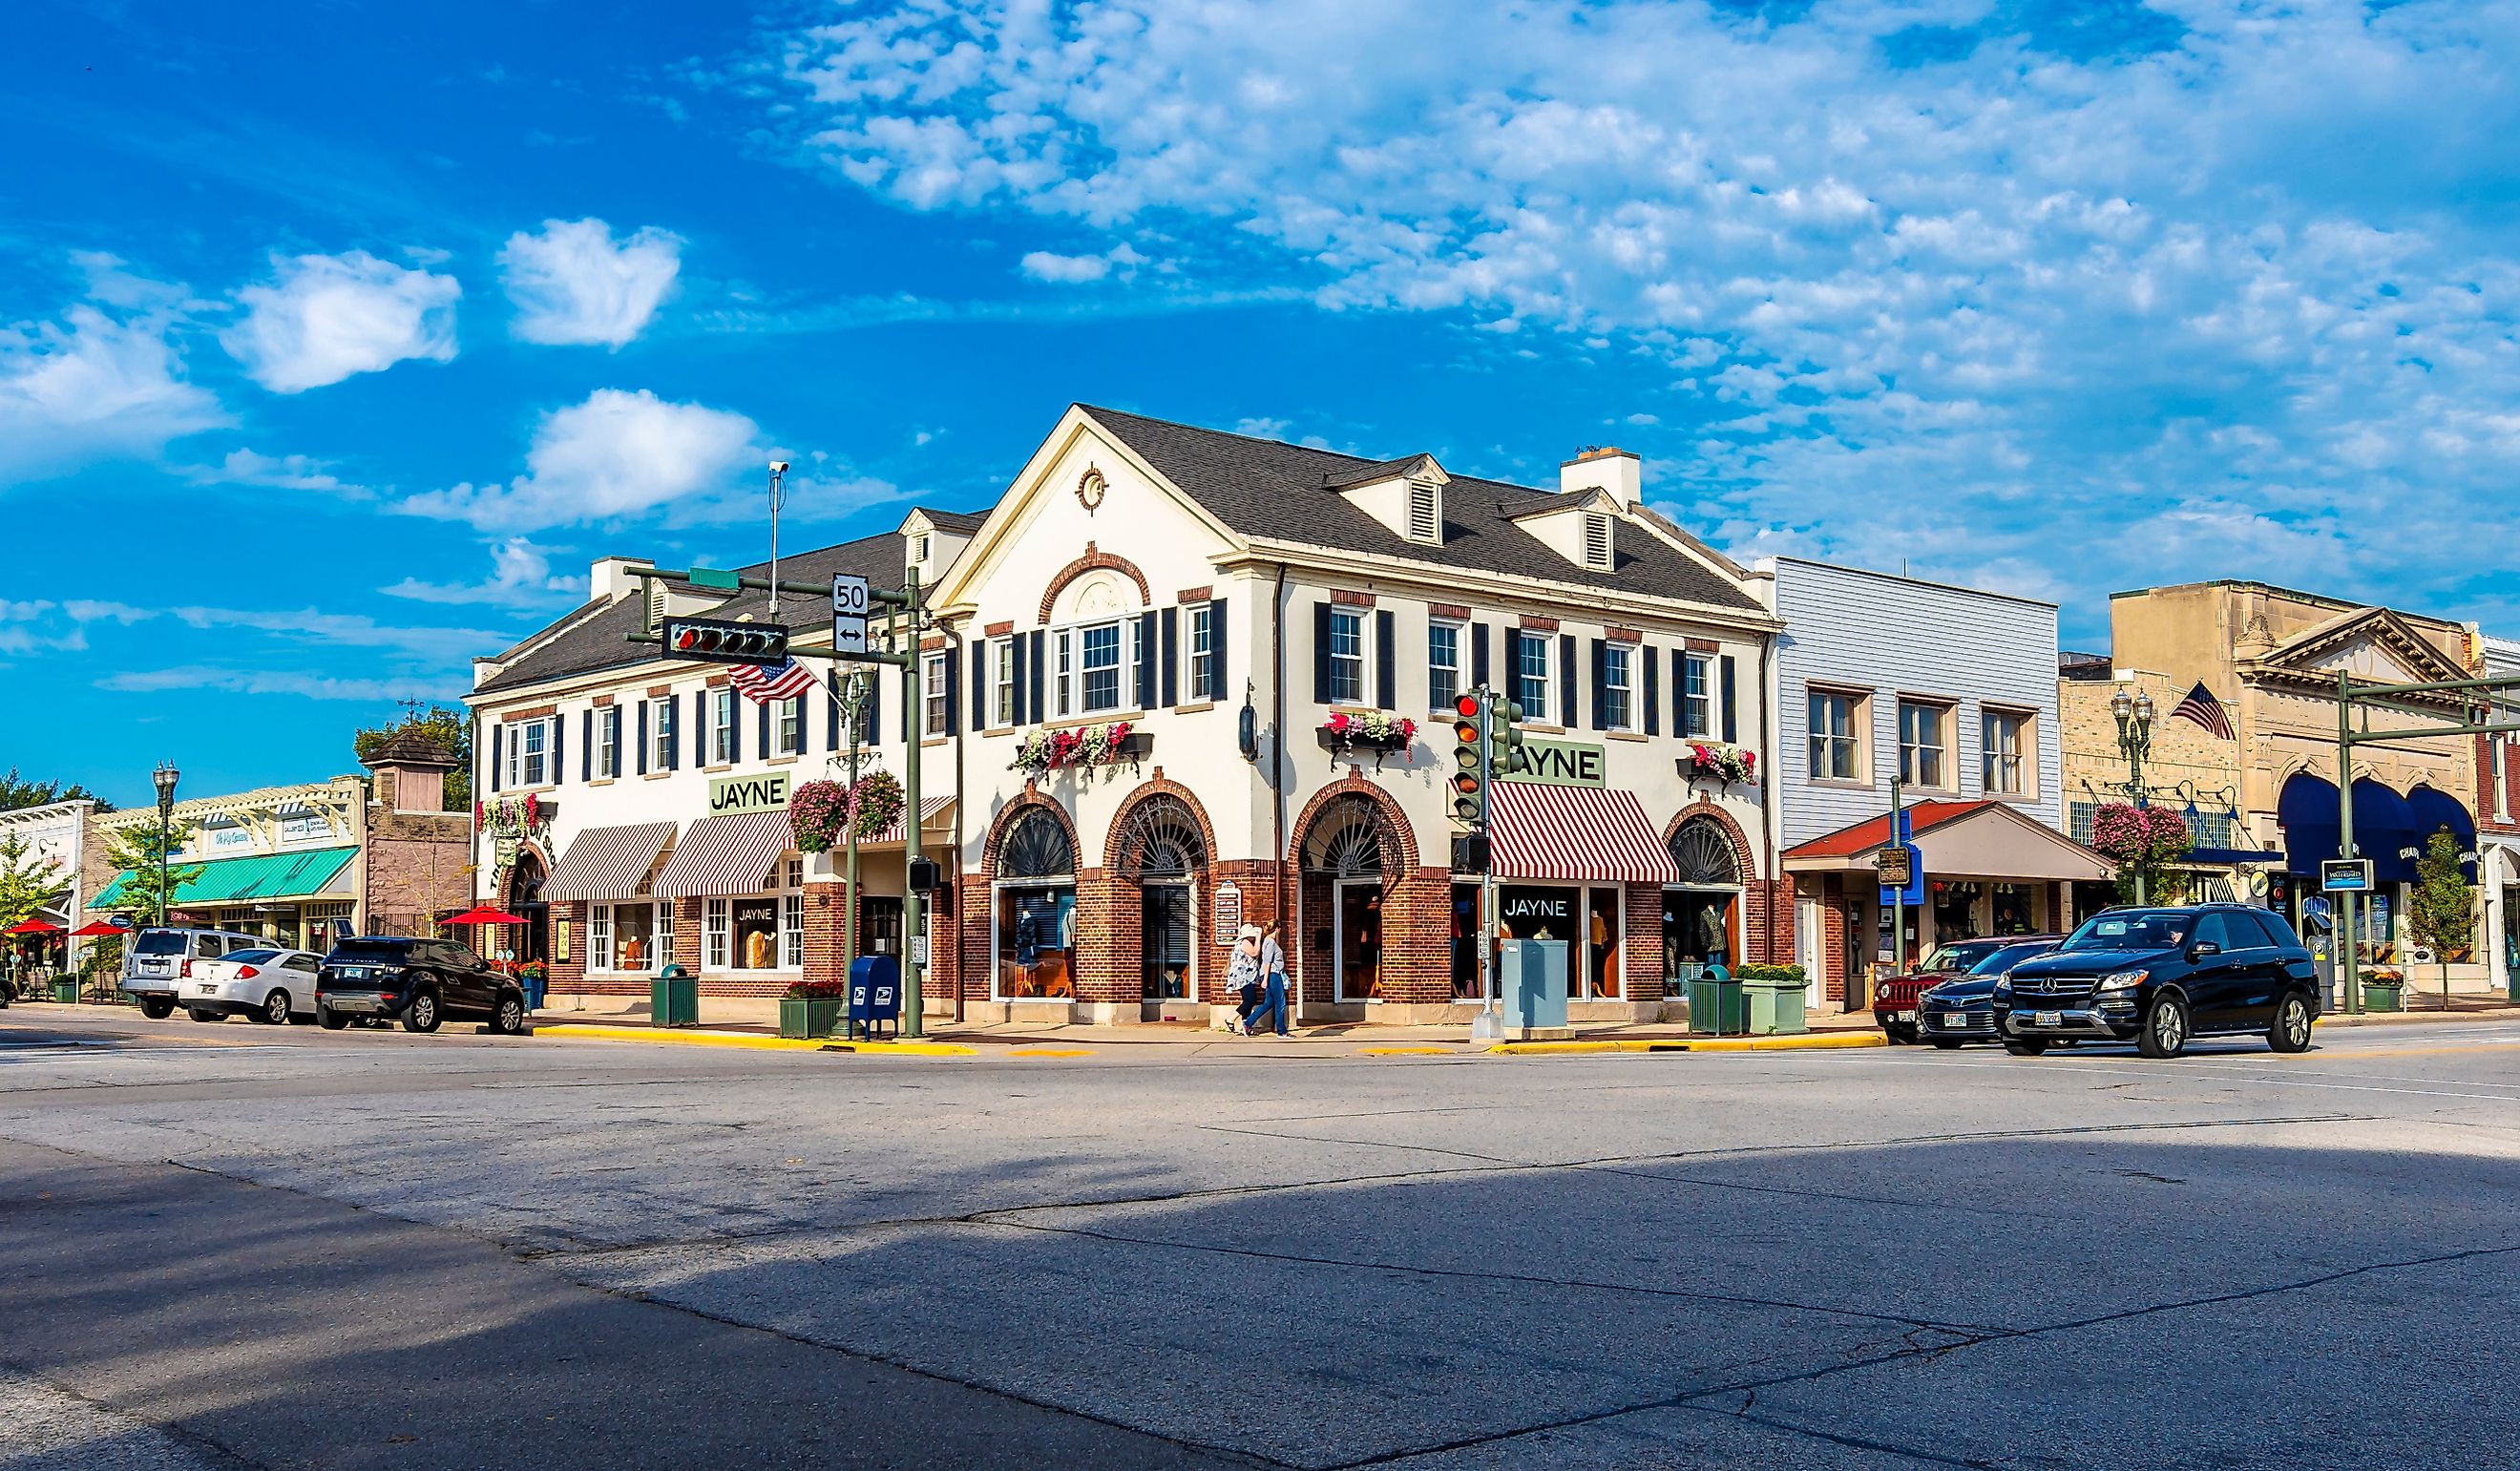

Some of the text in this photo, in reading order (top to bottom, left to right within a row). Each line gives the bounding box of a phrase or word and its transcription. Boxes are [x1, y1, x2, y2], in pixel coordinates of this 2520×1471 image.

[837, 585, 864, 608] 50
[1511, 746, 1600, 780] AYNE
[711, 779, 785, 809] JAYNE
[739, 908, 772, 921] JAYNE
[1505, 899, 1567, 916] JAYNE
